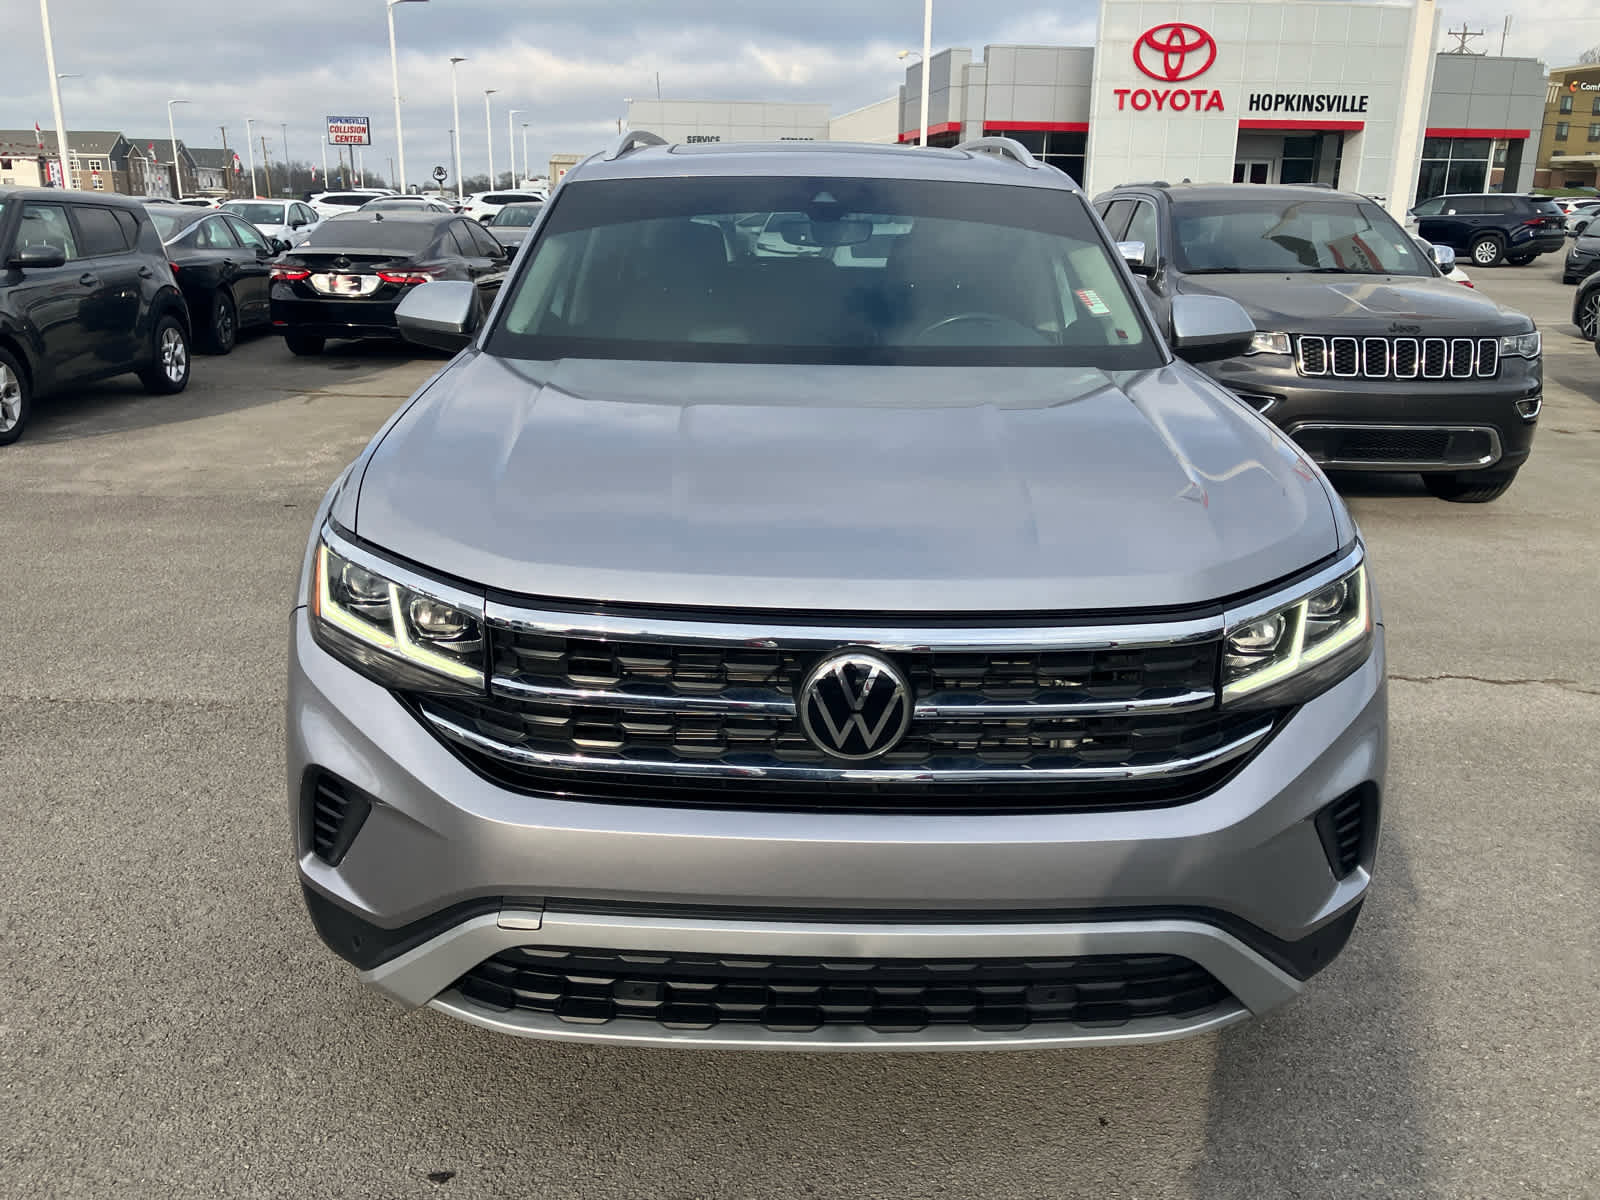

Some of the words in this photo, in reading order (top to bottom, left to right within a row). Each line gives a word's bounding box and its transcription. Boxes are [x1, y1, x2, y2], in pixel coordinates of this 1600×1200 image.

[1114, 89, 1225, 111] TOYOTA
[1249, 93, 1368, 113] HOPKINSVILLE
[329, 125, 366, 134] COLLISION
[335, 134, 363, 143] CENTER
[687, 135, 720, 144] SERVICE
